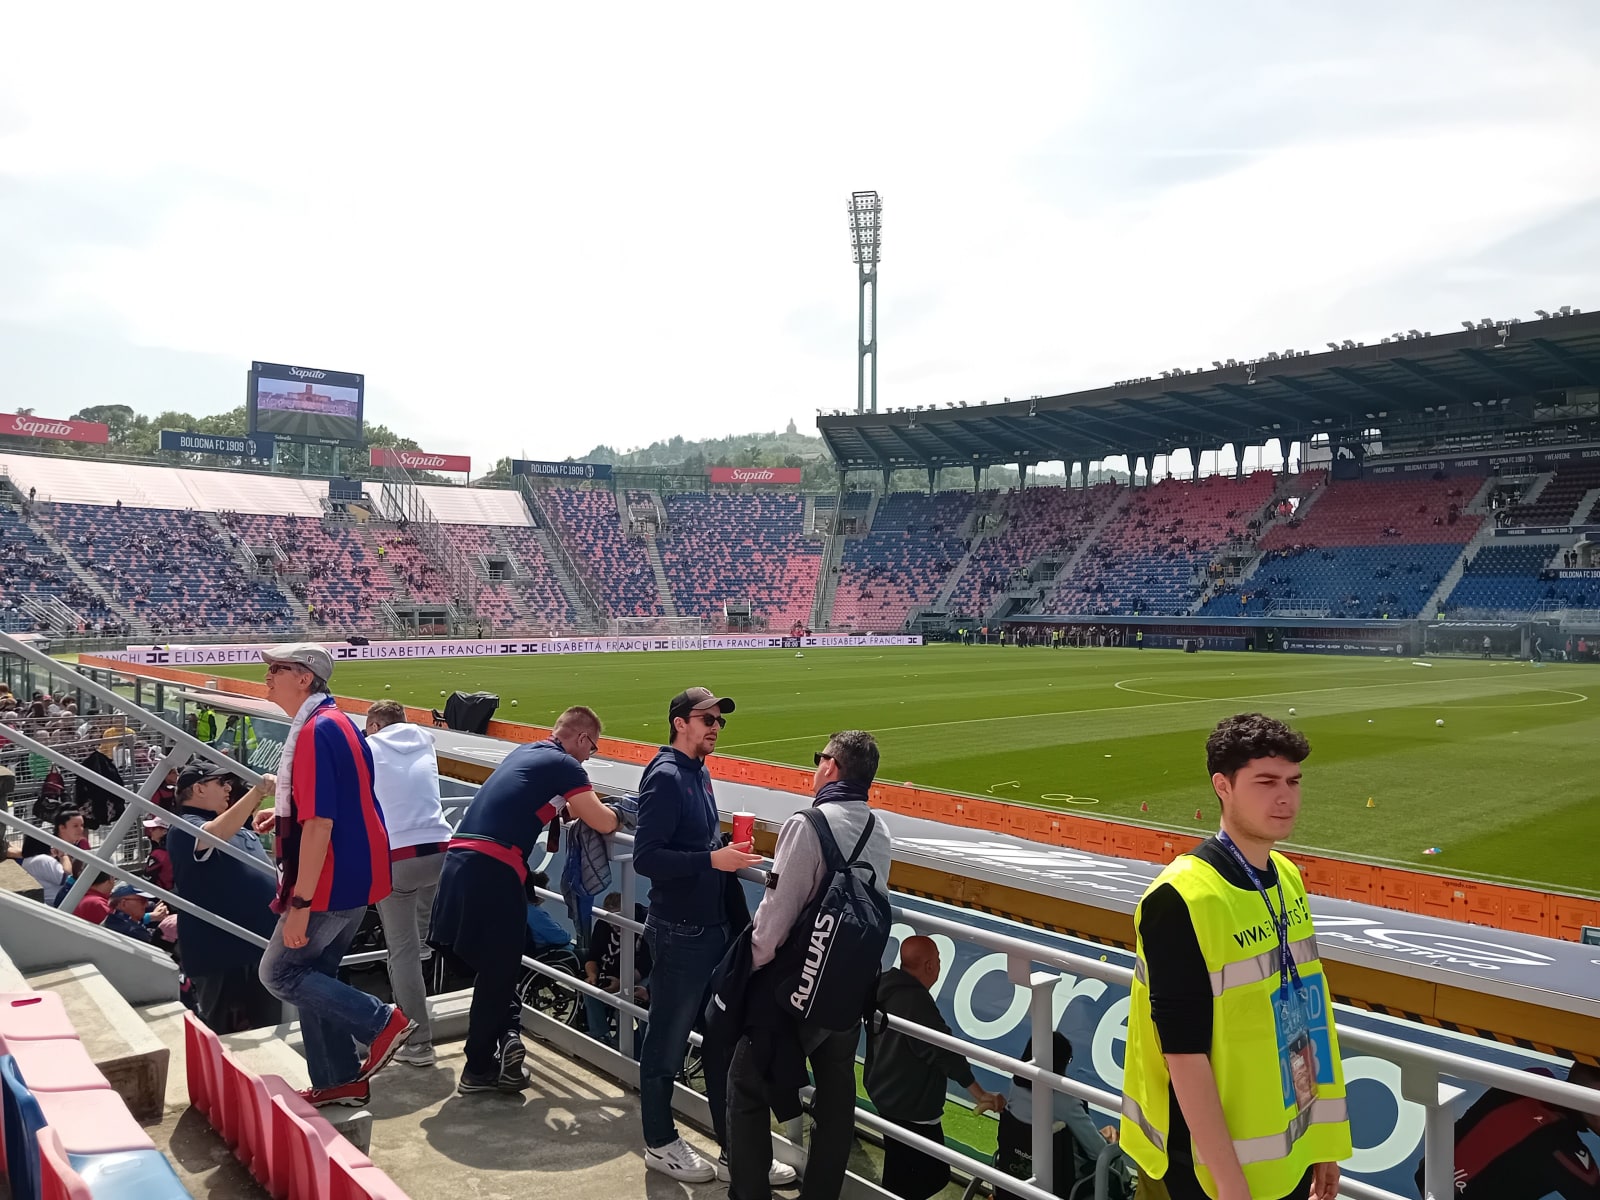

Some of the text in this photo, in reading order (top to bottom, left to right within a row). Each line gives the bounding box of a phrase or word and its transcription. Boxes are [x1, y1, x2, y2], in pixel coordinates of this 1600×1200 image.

[289, 366, 327, 379] Saputo
[11, 416, 74, 437] Saputo
[180, 436, 245, 451] BOLOGNA FC 1909
[400, 452, 447, 468] Saputo
[531, 463, 584, 476] BOLOGNA FC 1909
[730, 468, 775, 483] Saputo
[1560, 571, 1582, 579] BOLOGNA
[541, 641, 652, 653] ELISABETTA FRANCHI
[671, 638, 766, 650] ELISABETTA FRANCHI
[822, 636, 905, 646] ELISABETTA FRANCHI
[175, 651, 261, 664] ELISABETTA
[362, 645, 497, 658] ELISABETTA FRANCHI
